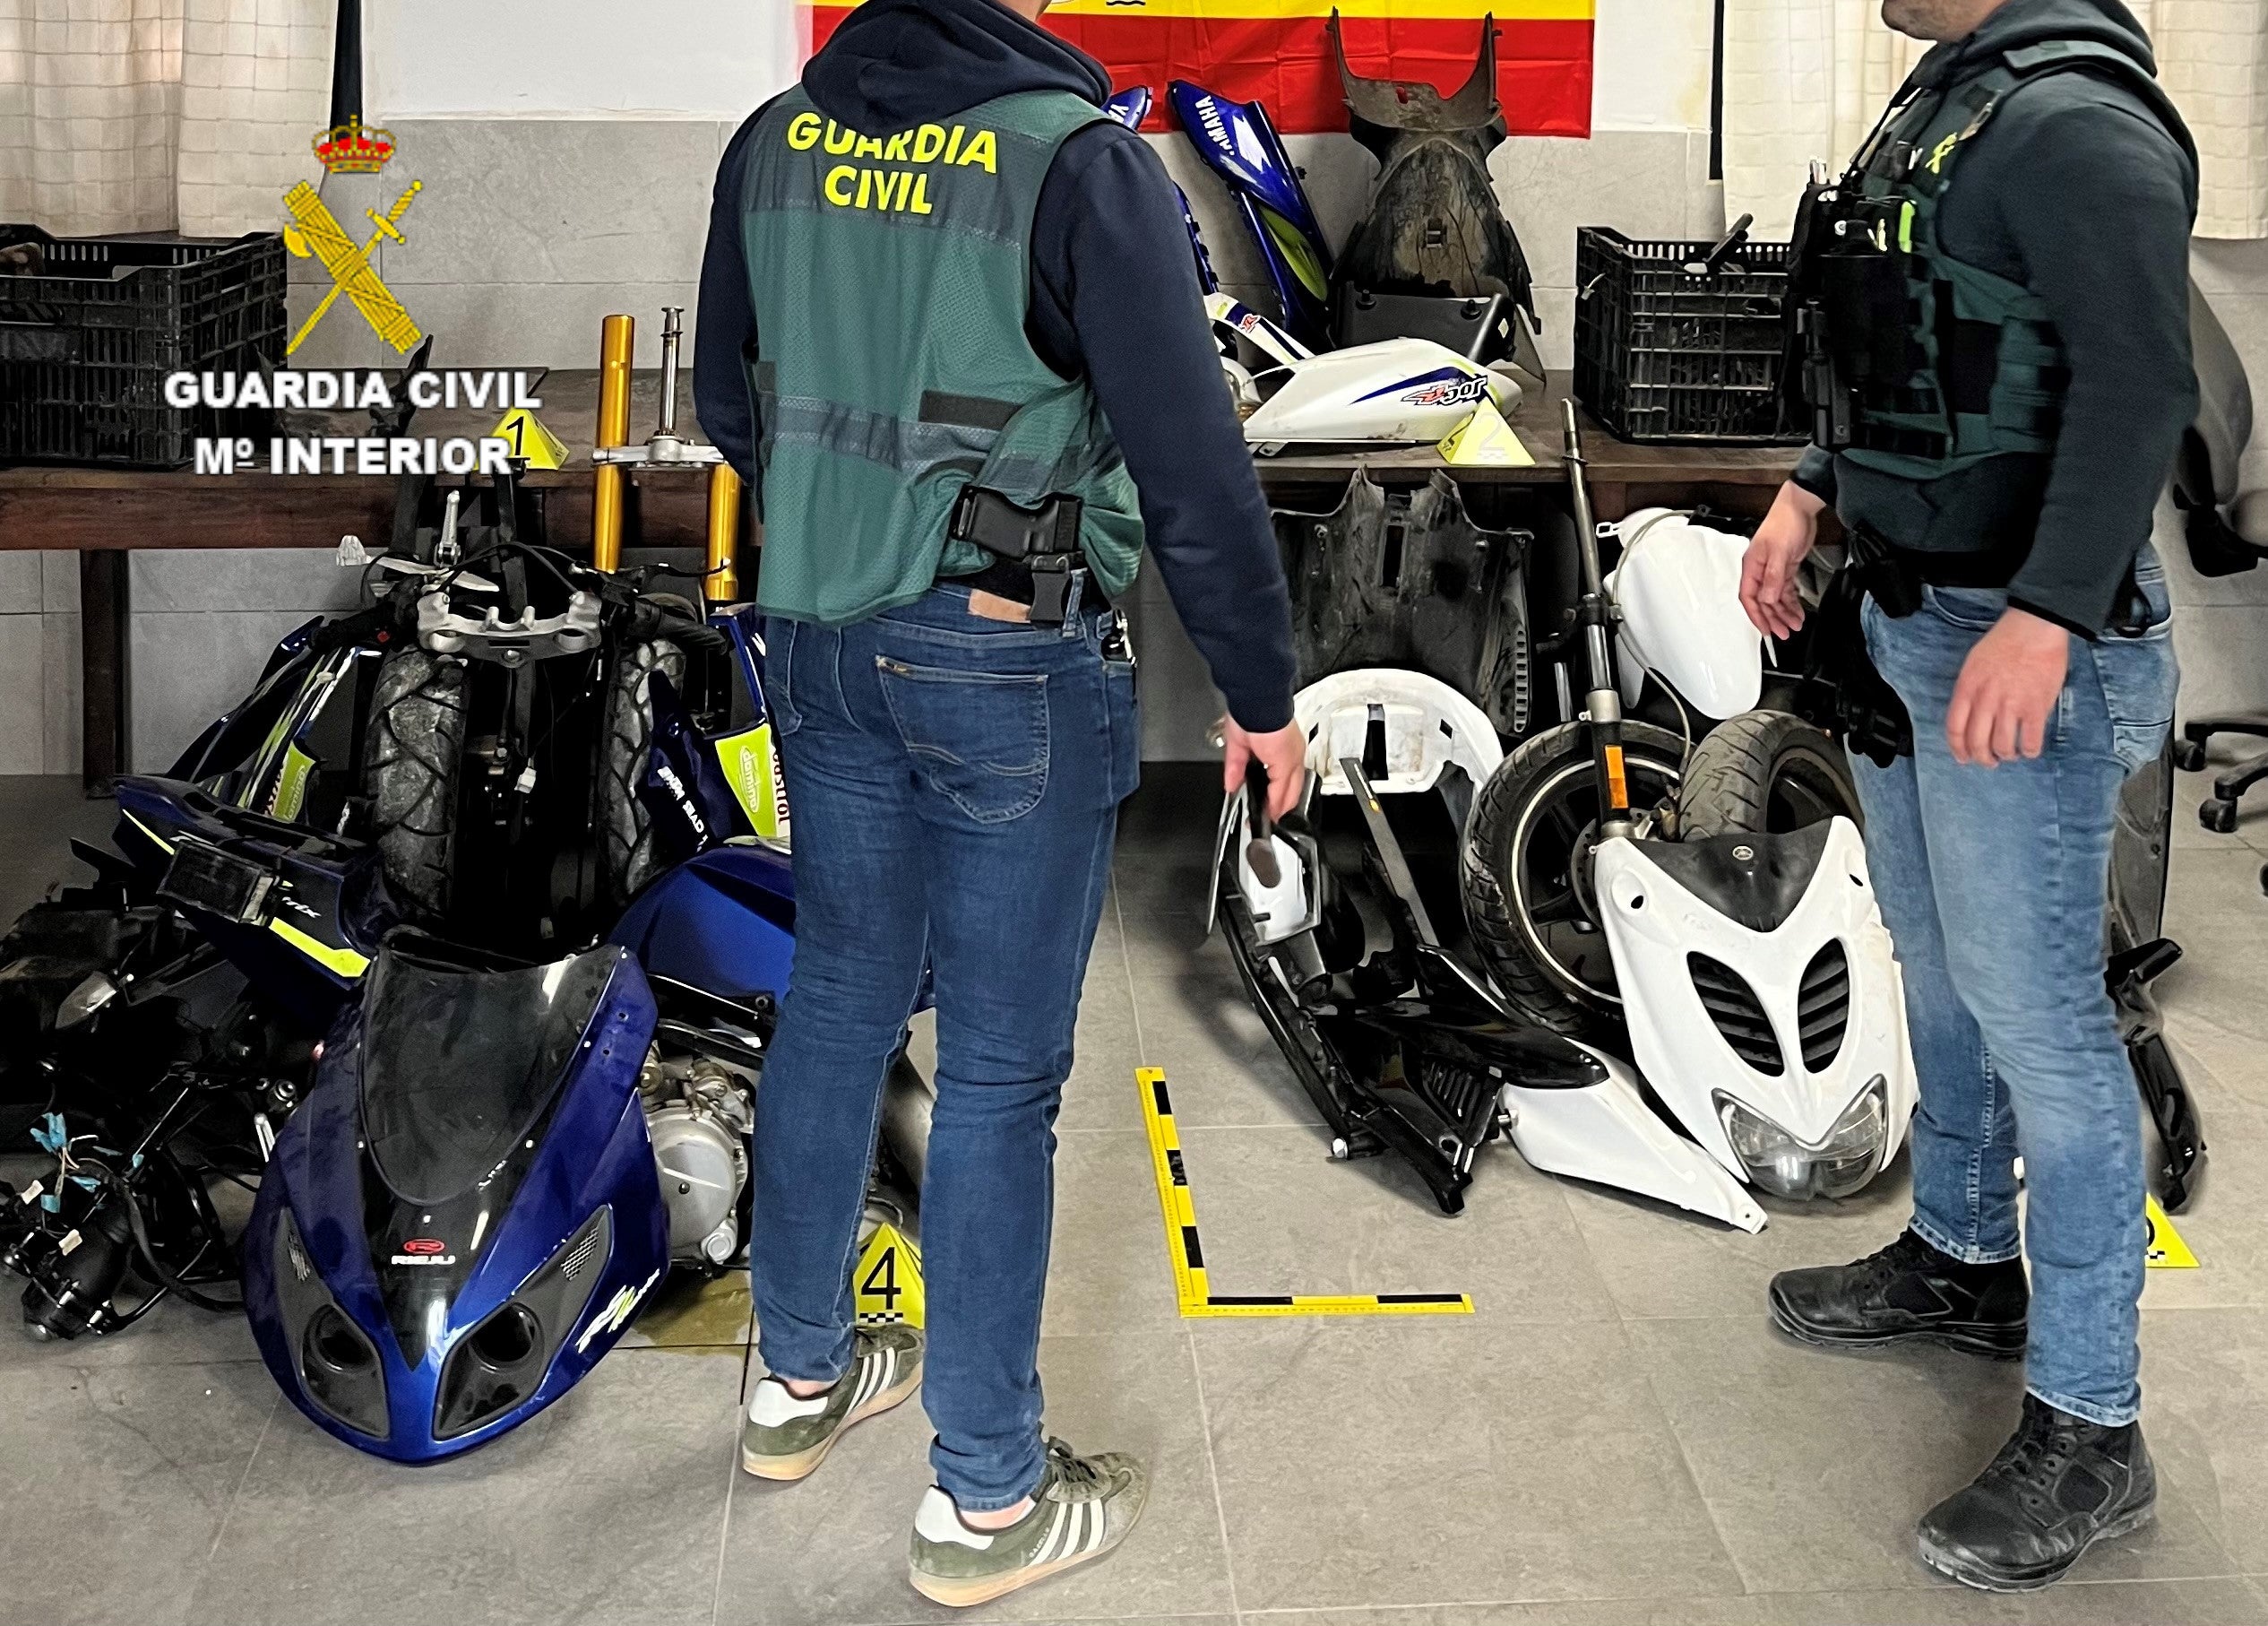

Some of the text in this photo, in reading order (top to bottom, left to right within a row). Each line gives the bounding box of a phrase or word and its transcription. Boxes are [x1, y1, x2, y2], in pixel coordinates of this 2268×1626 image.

[788, 112, 997, 174] GUARDIA
[1194, 95, 1235, 156] AMAHA
[824, 165, 933, 214] CIVIL
[506, 416, 523, 456] 1
[1479, 412, 1505, 451] 2
[740, 751, 761, 813] domino
[861, 1247, 901, 1310] 4
